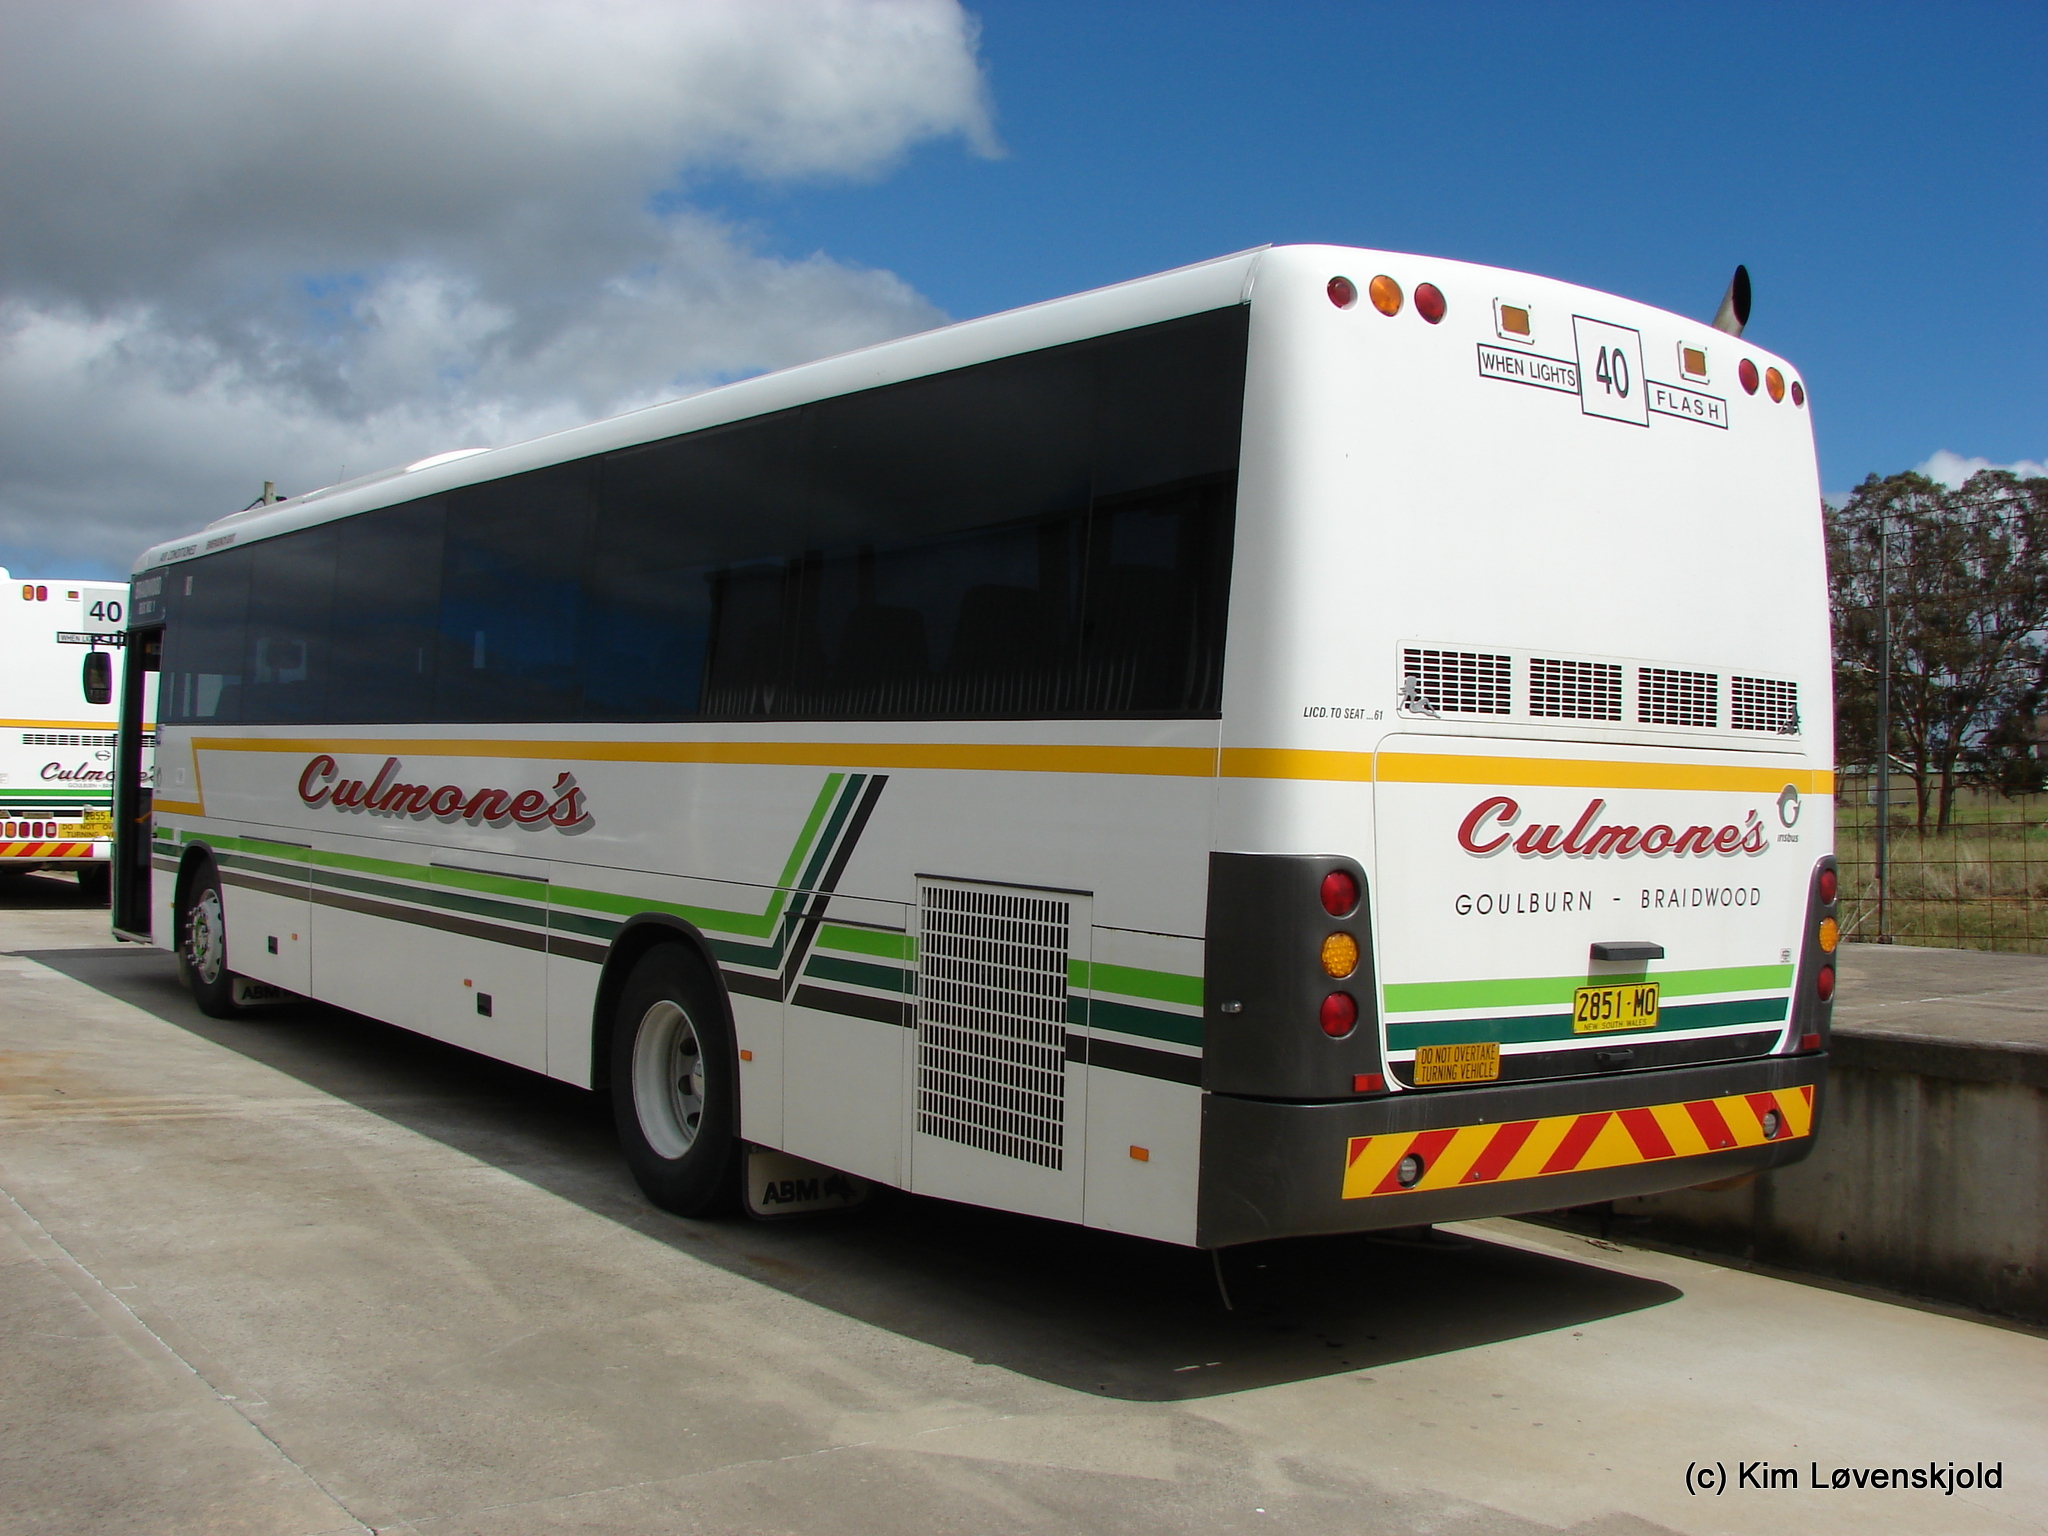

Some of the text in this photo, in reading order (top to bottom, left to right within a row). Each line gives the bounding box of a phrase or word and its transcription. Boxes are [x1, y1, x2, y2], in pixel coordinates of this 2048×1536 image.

[1482, 352, 1576, 386] WHEN LIGHTS
[1596, 346, 1629, 399] 40
[1656, 389, 1719, 421] FLASH
[89, 600, 122, 622] 40
[1303, 706, 1328, 719] LICD.
[1330, 707, 1342, 719] TO
[1343, 708, 1365, 720] SEAT
[298, 754, 597, 836] Culmone's
[62, 823, 74, 831] DO
[80, 823, 96, 831] NOT
[1457, 795, 1771, 860] Culmone's
[1455, 890, 1593, 916] GOULBURN
[1640, 887, 1761, 909] BRAIDWOOD
[1583, 1018, 1647, 1031] NEW SOUTH WALES
[1421, 1043, 1497, 1065] DO NOT OVERTAKE
[1421, 1061, 1494, 1083] TURNING VEHICLE
[762, 1178, 819, 1205] ABM
